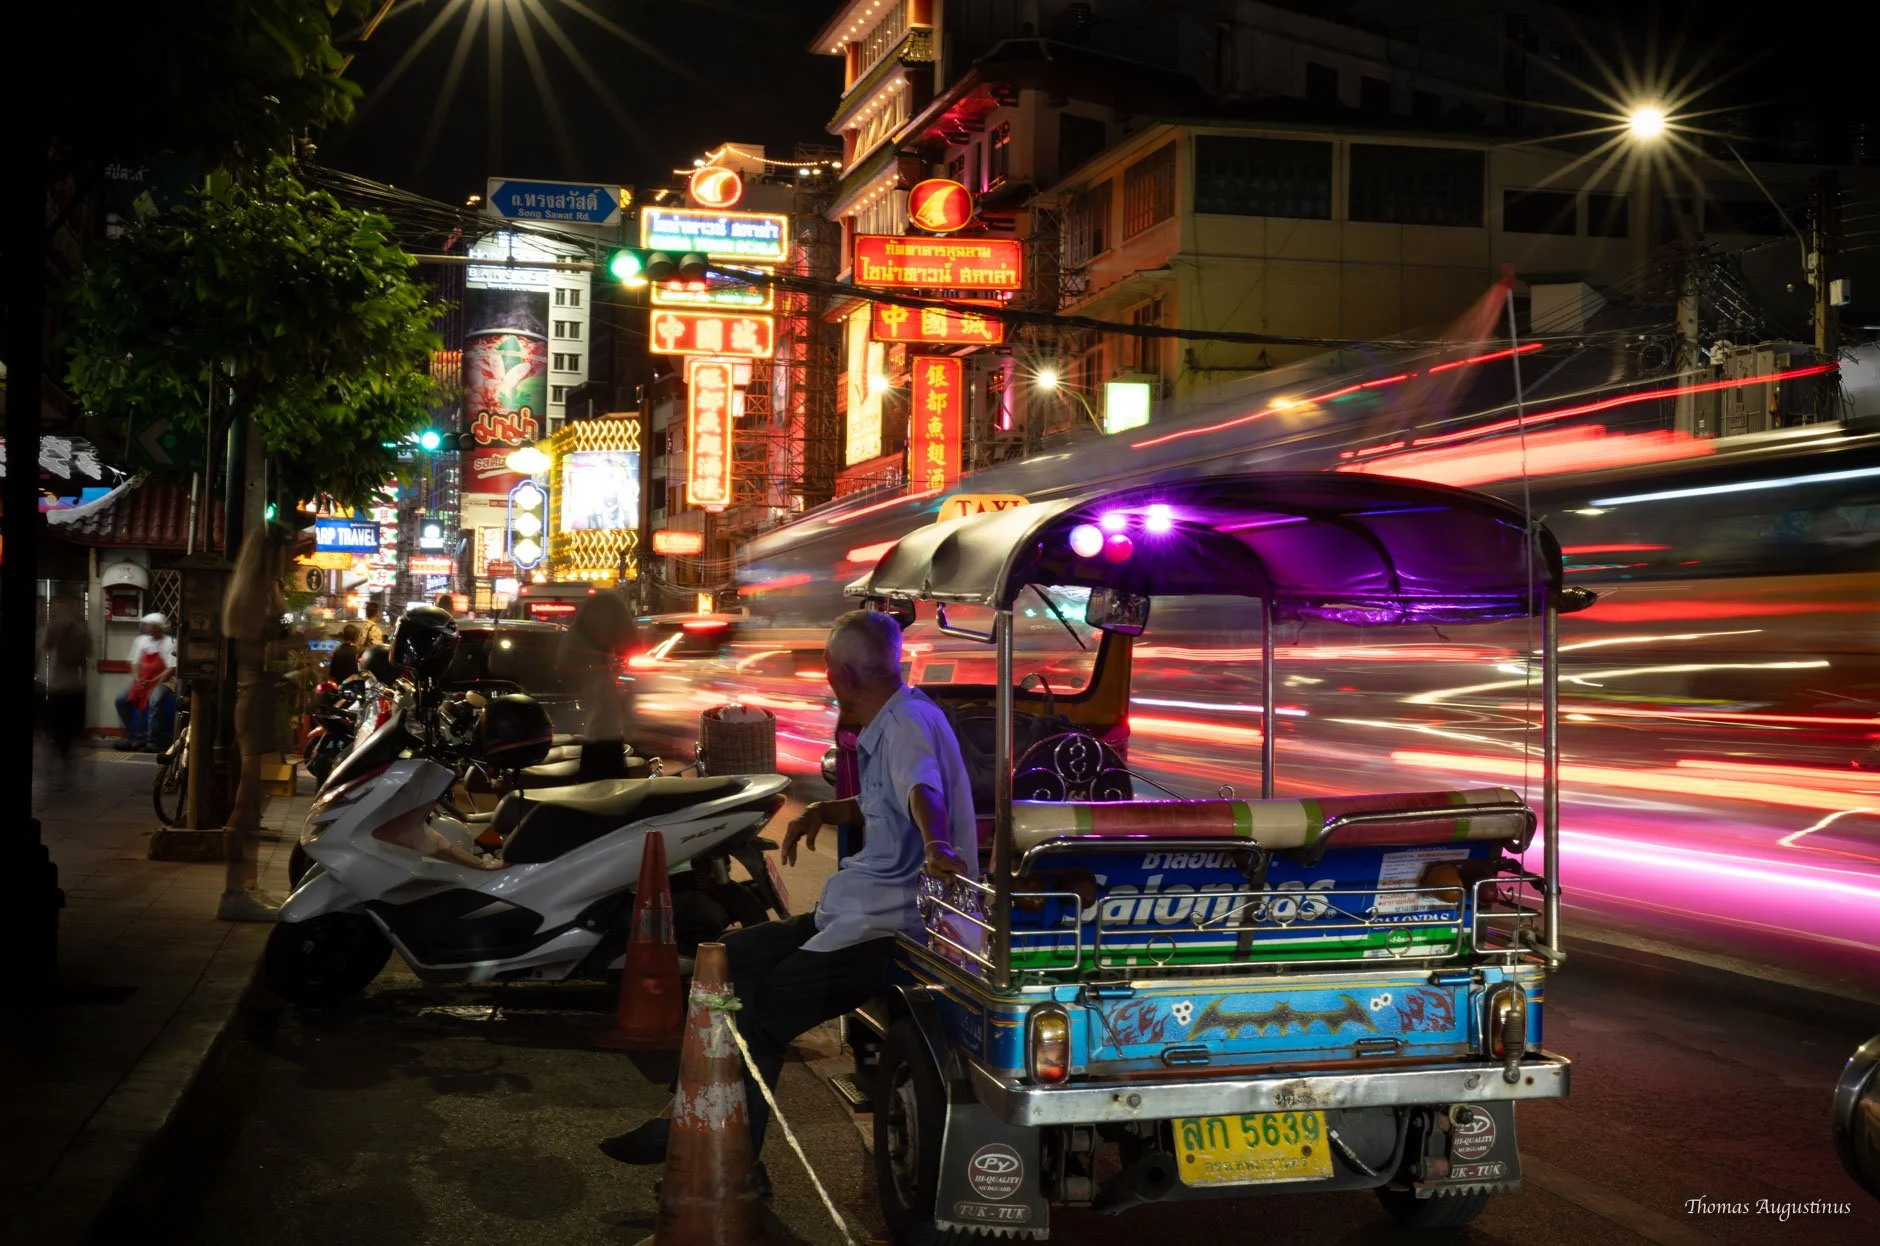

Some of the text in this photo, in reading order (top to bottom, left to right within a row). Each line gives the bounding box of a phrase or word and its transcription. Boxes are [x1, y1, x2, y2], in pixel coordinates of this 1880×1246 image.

[511, 188, 601, 211] ถ.ทรงสวัสดิ์
[518, 208, 590, 220] Song Sawat Rd.
[860, 256, 1017, 284] ไชน่าทาวน์ สกาล่า
[471, 406, 539, 446] มาม่า
[337, 527, 378, 546] TRAVEL
[1240, 1111, 1320, 1149] 5639
[1454, 1135, 1493, 1145] HI-QUALITY
[1477, 1165, 1501, 1176] TUK
[975, 1175, 1020, 1184] HI-QUALITY
[959, 1205, 988, 1217] TUK
[998, 1207, 1026, 1219] TUK
